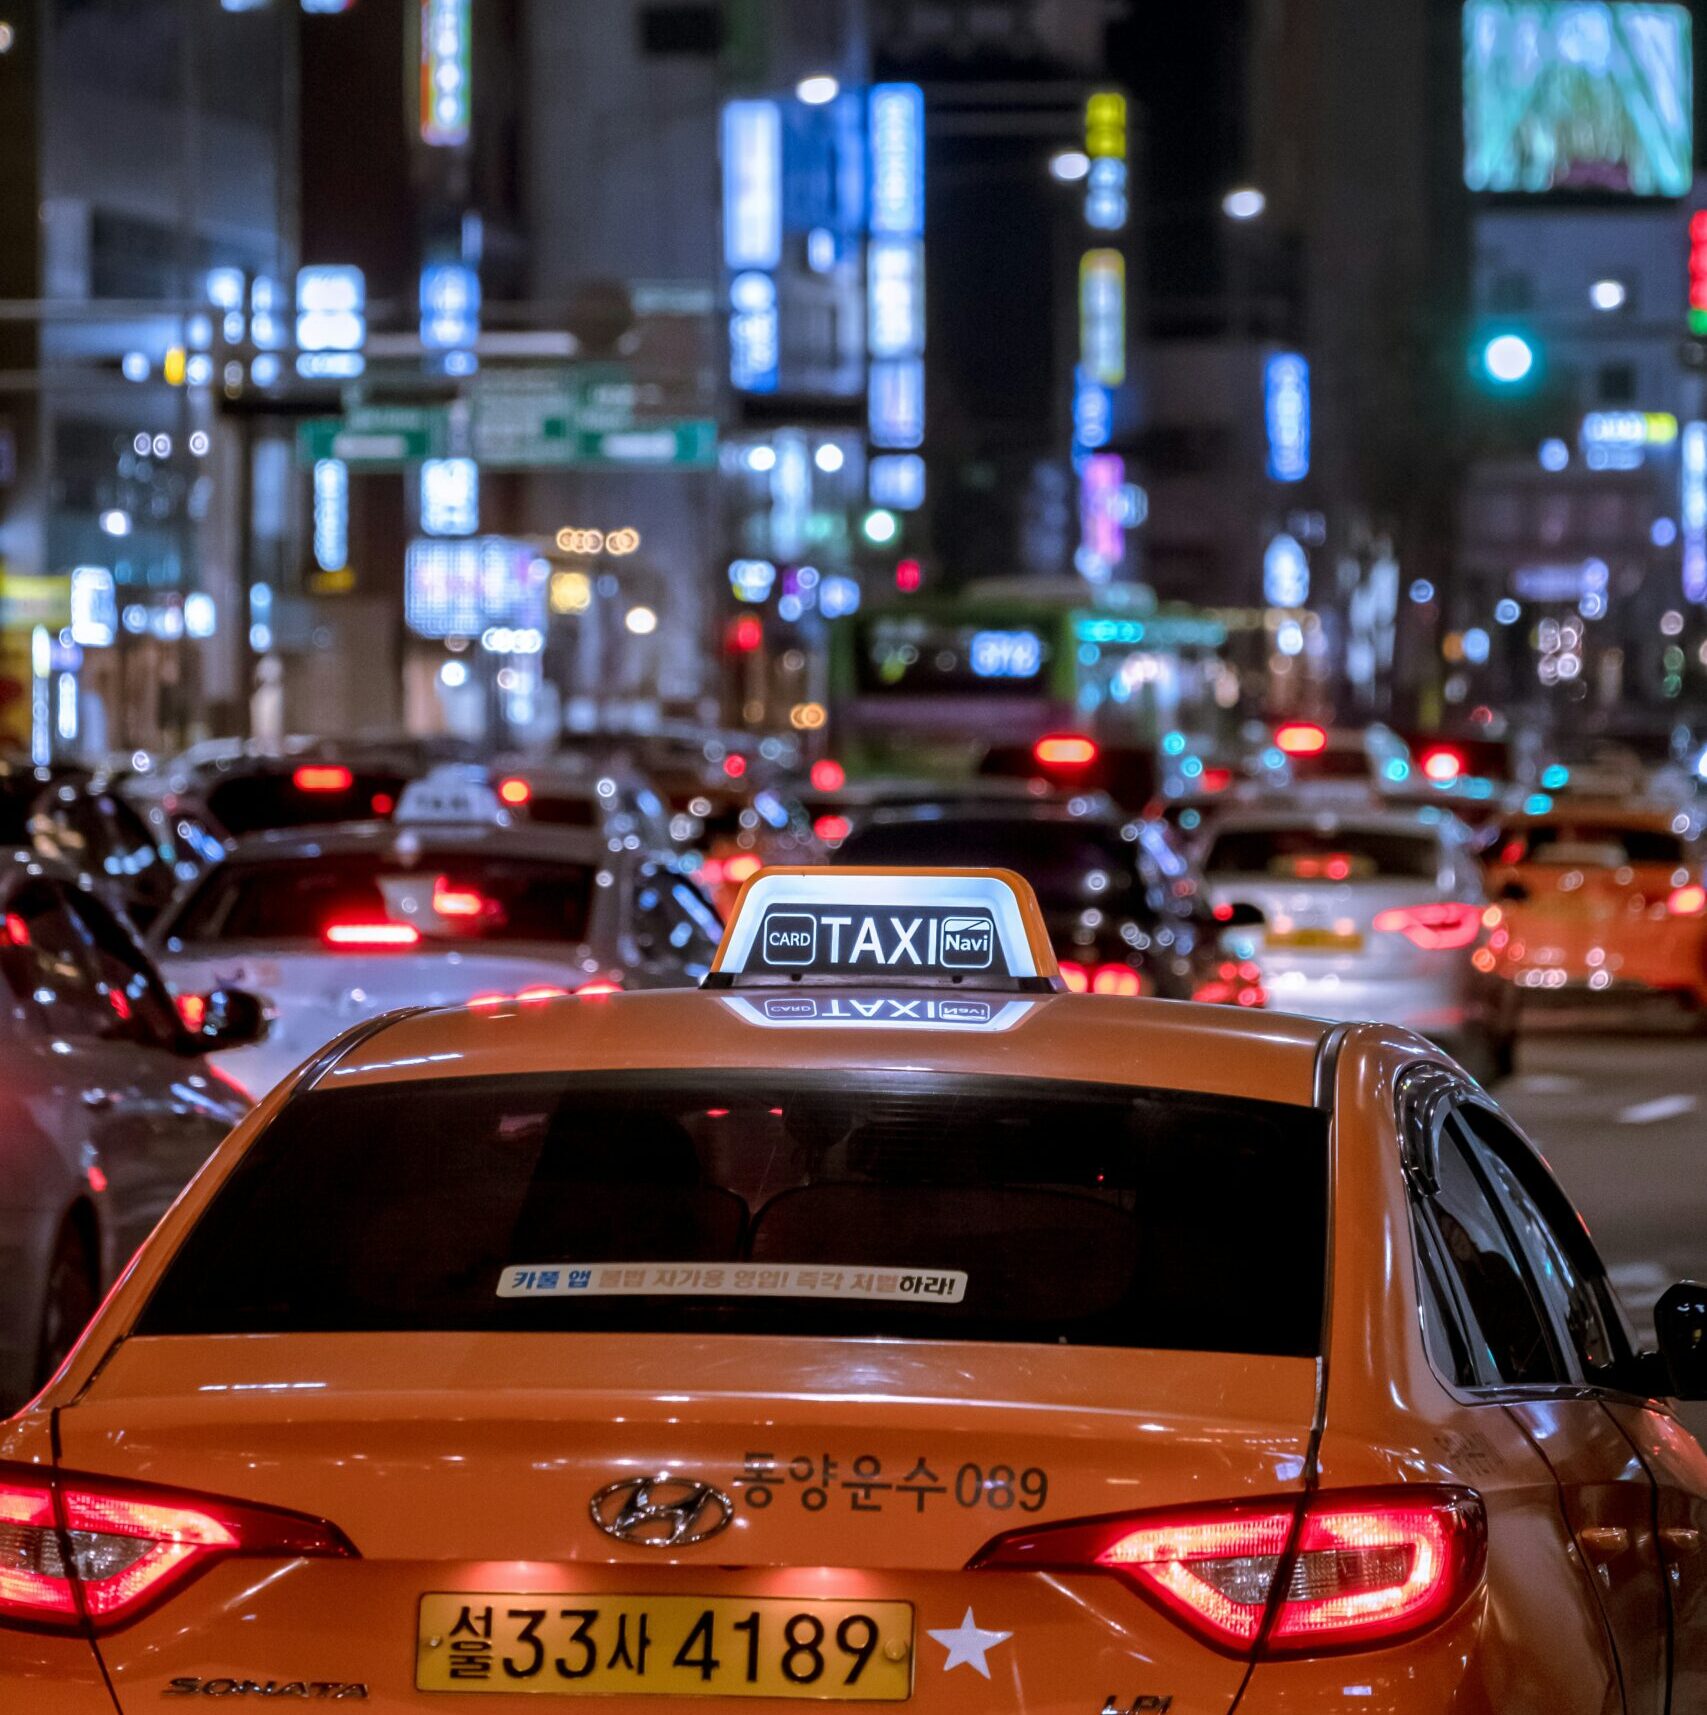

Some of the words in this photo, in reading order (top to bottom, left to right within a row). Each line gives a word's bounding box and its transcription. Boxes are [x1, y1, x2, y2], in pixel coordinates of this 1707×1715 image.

[768, 932, 812, 947] CARD
[820, 916, 938, 966] TAXI
[944, 933, 989, 952] Navi
[567, 1269, 592, 1289] 앱
[651, 1268, 725, 1289] 자가용
[733, 1269, 790, 1290] 영업!
[796, 1271, 845, 1291] 즉각
[672, 1610, 880, 1686] 4189
[161, 1677, 370, 1700] SONATA
